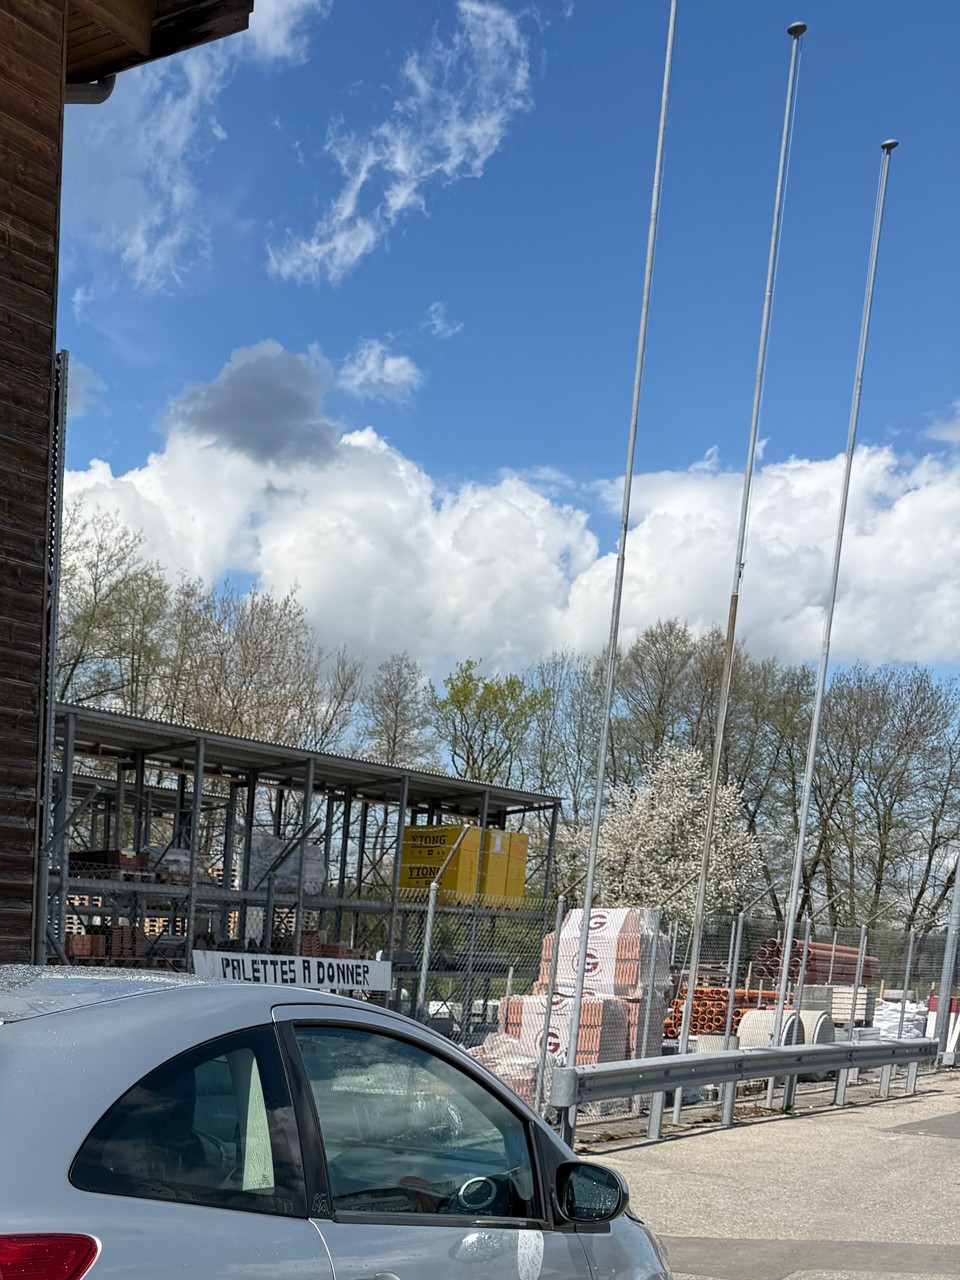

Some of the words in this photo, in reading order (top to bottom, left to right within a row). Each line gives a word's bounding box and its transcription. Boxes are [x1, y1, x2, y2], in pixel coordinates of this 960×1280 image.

[411, 835, 446, 846] YTONG
[408, 867, 440, 877] YTON
[221, 957, 296, 984] PALETTES
[302, 959, 311, 983] A
[316, 961, 370, 986] DONNER
